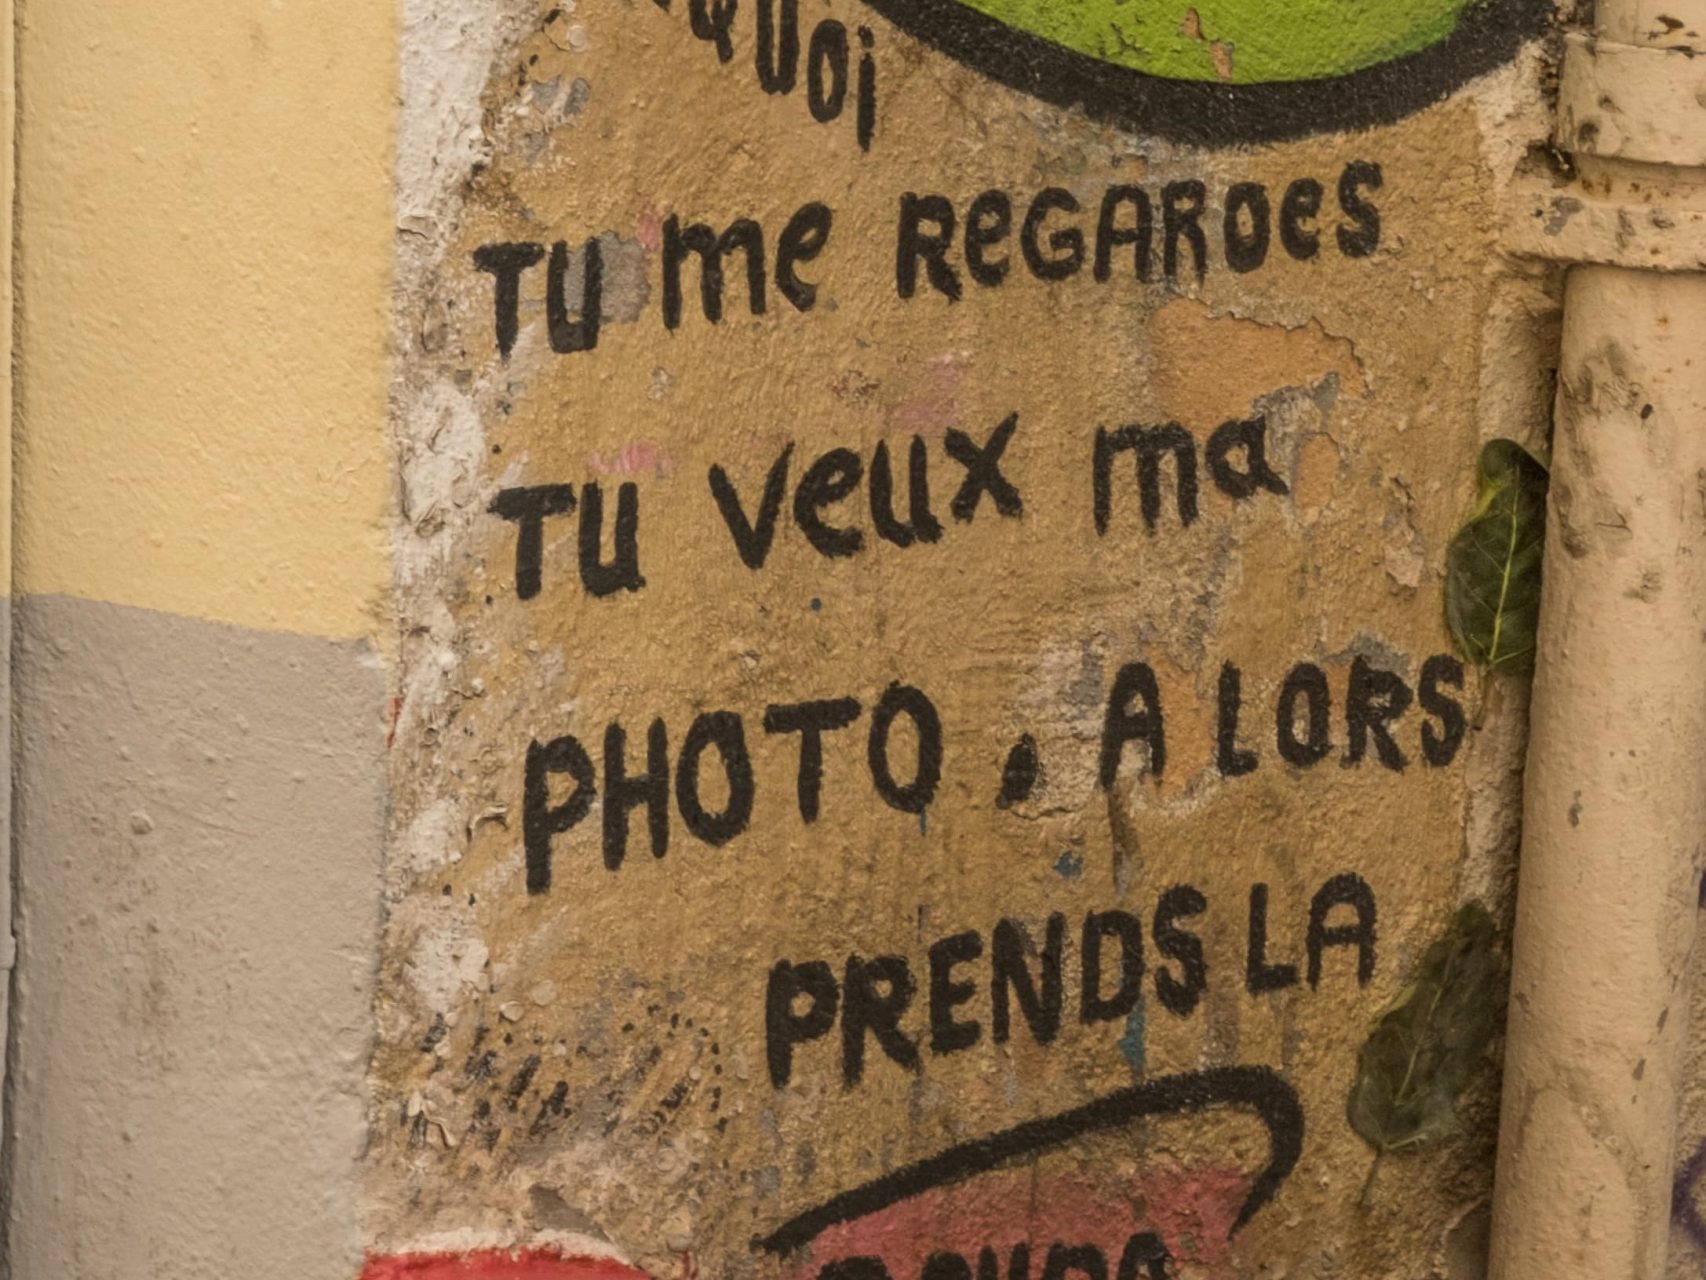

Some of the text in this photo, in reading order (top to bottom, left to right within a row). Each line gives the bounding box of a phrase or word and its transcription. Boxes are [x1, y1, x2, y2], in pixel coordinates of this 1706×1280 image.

[472, 235, 601, 361] TU
[661, 202, 832, 333] me
[487, 480, 646, 600] TU
[1093, 414, 1289, 537] ma
[765, 872, 1377, 1091] PRENDS LA
